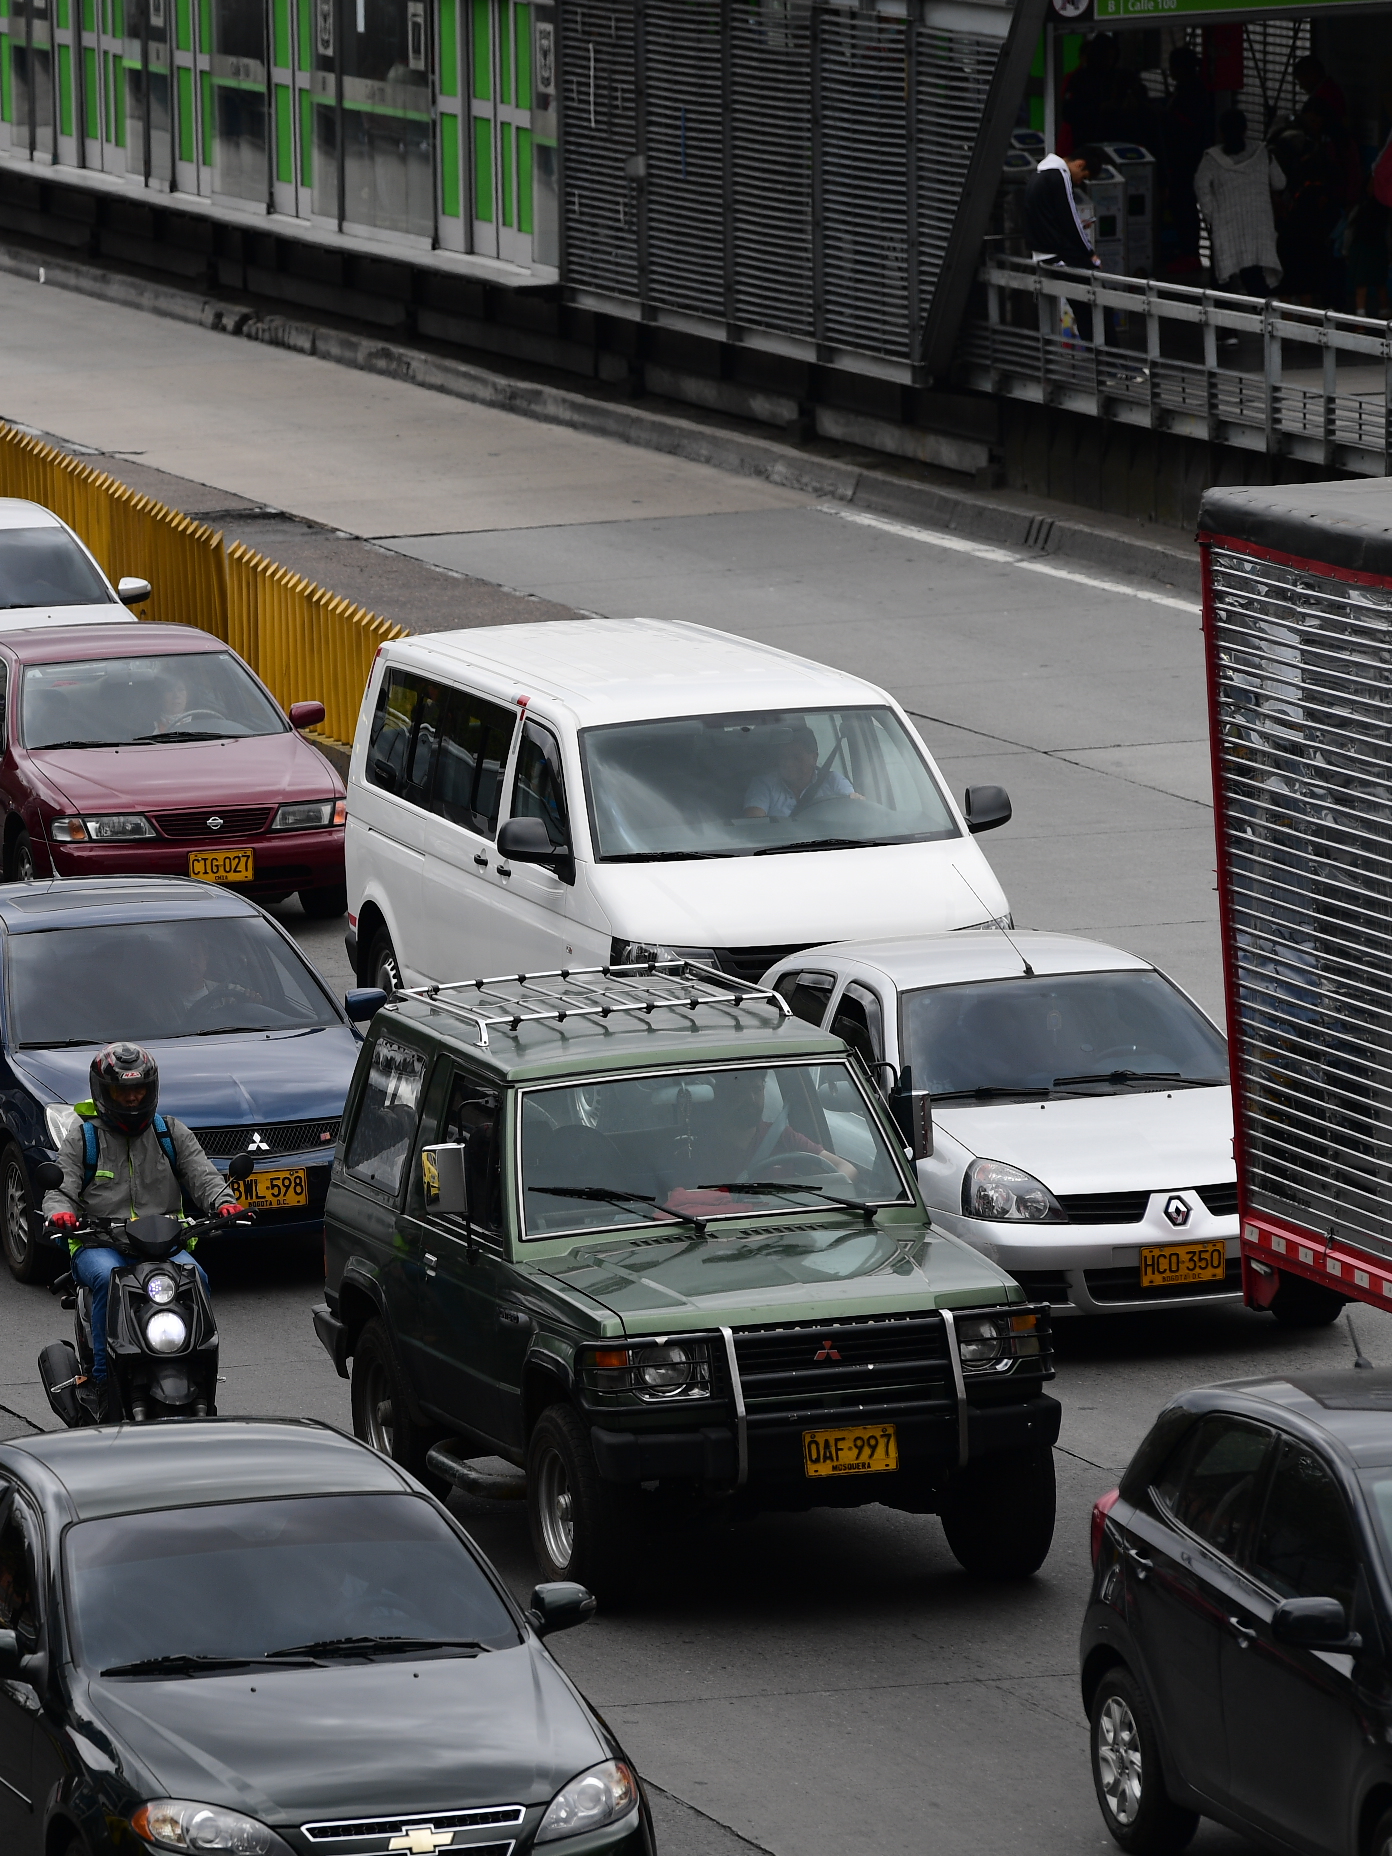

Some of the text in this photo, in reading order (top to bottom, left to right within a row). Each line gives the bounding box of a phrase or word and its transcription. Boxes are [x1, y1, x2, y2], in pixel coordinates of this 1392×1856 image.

[1128, 0, 1154, 11] Calle
[1158, 0, 1177, 10] 100
[248, 1200, 273, 1208] BOGOTA
[1161, 1275, 1188, 1283] BOGOTA
[831, 1461, 872, 1472] MOSQUERA
